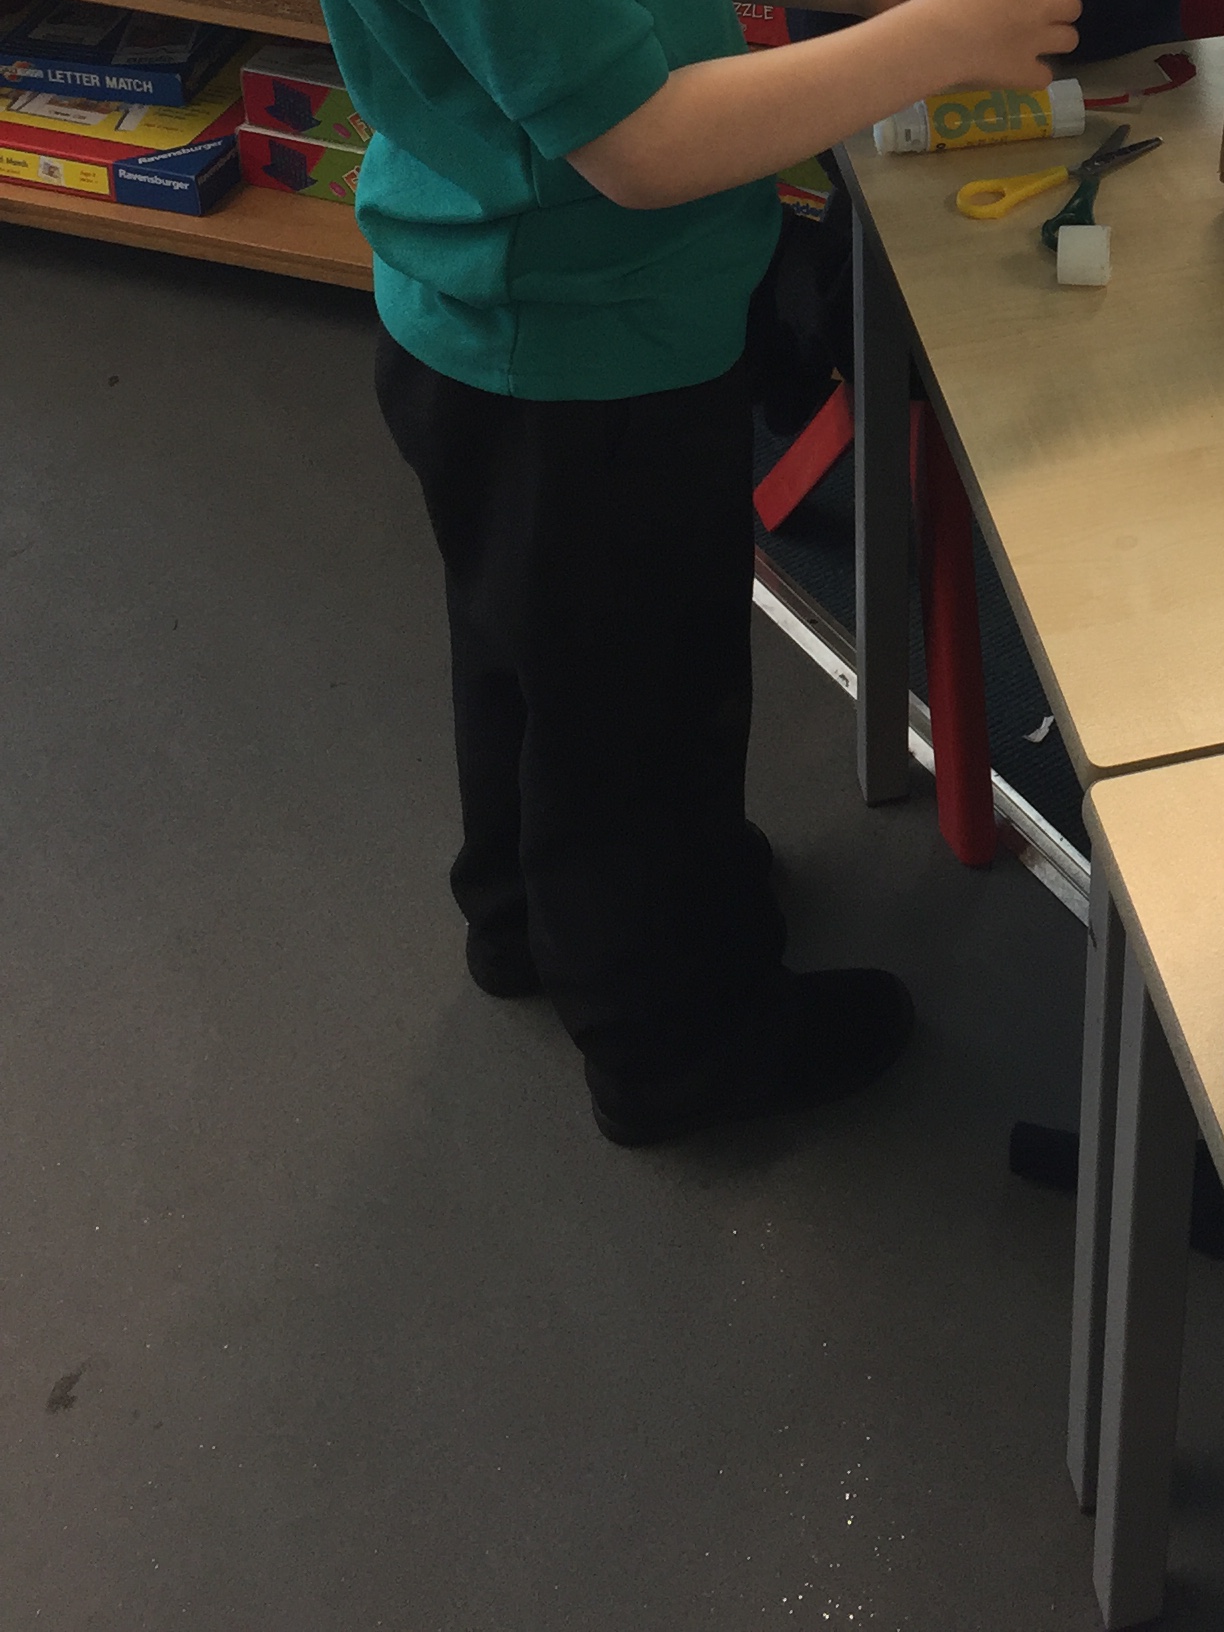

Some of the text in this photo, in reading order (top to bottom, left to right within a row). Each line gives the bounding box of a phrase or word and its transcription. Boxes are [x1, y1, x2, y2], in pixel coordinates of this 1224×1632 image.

[48, 69, 101, 88] LETTER
[105, 76, 153, 94] MATCH
[138, 139, 224, 165] Ravensburger
[118, 169, 190, 191] Ravensburger
